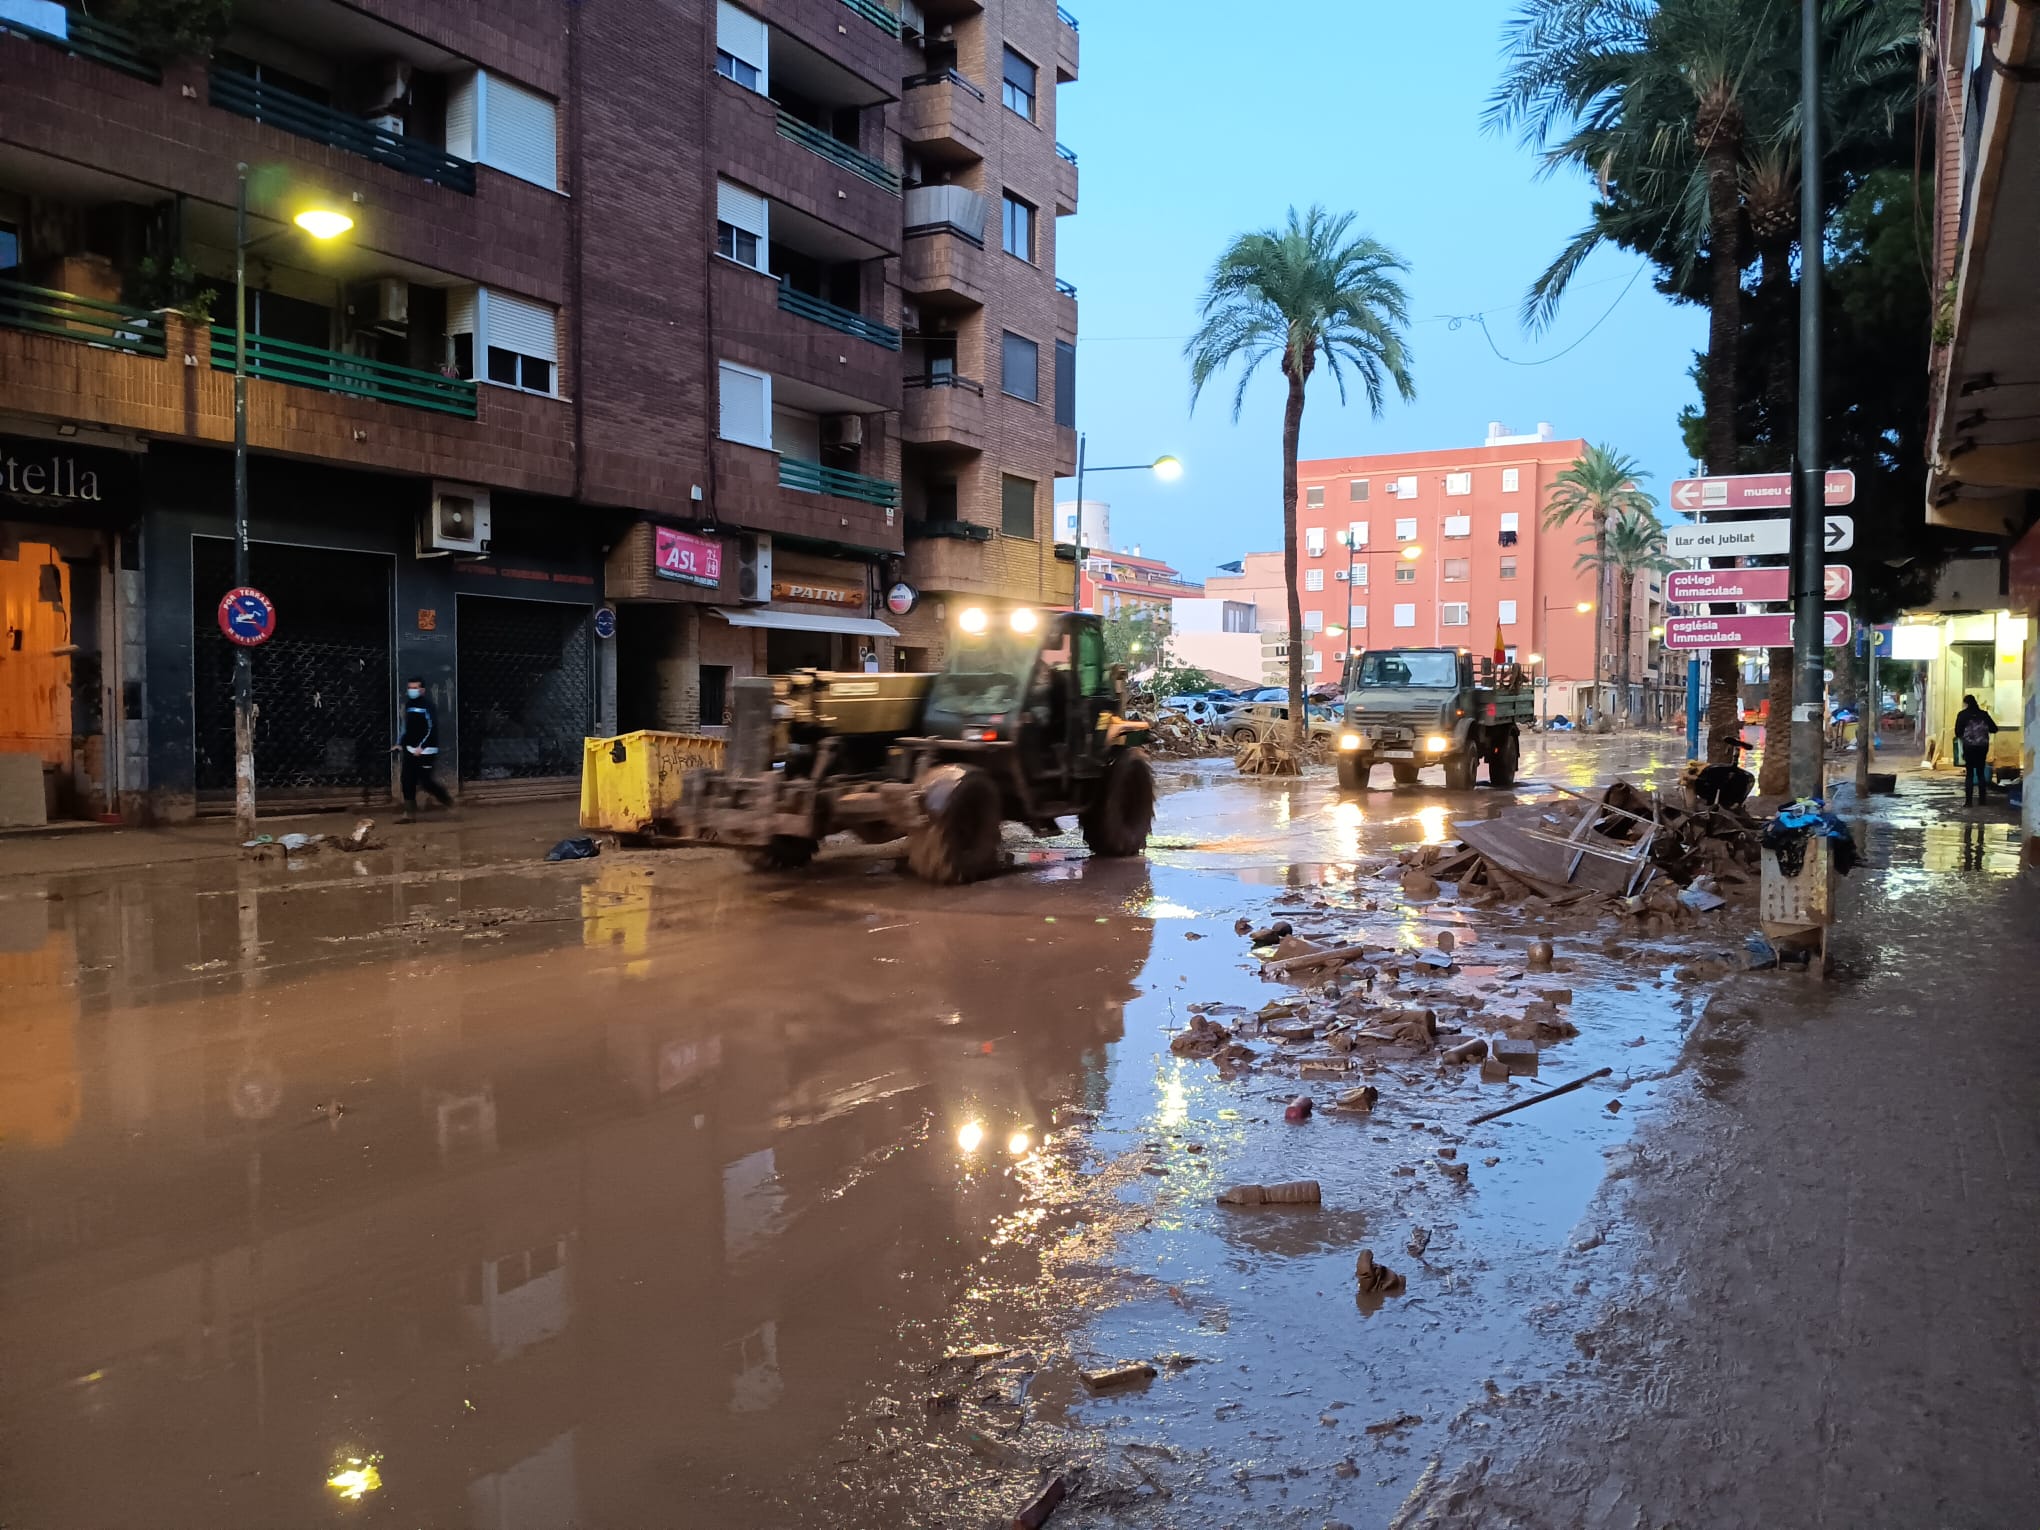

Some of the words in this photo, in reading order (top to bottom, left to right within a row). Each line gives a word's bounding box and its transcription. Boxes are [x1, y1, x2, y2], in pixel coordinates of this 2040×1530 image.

[0, 450, 102, 502] tella
[1744, 486, 1781, 497] museu
[1675, 536, 1694, 546] llar
[1697, 534, 1715, 545] del
[1718, 533, 1755, 546] jubilat
[666, 547, 697, 572] ASL
[789, 585, 846, 602] PATRI
